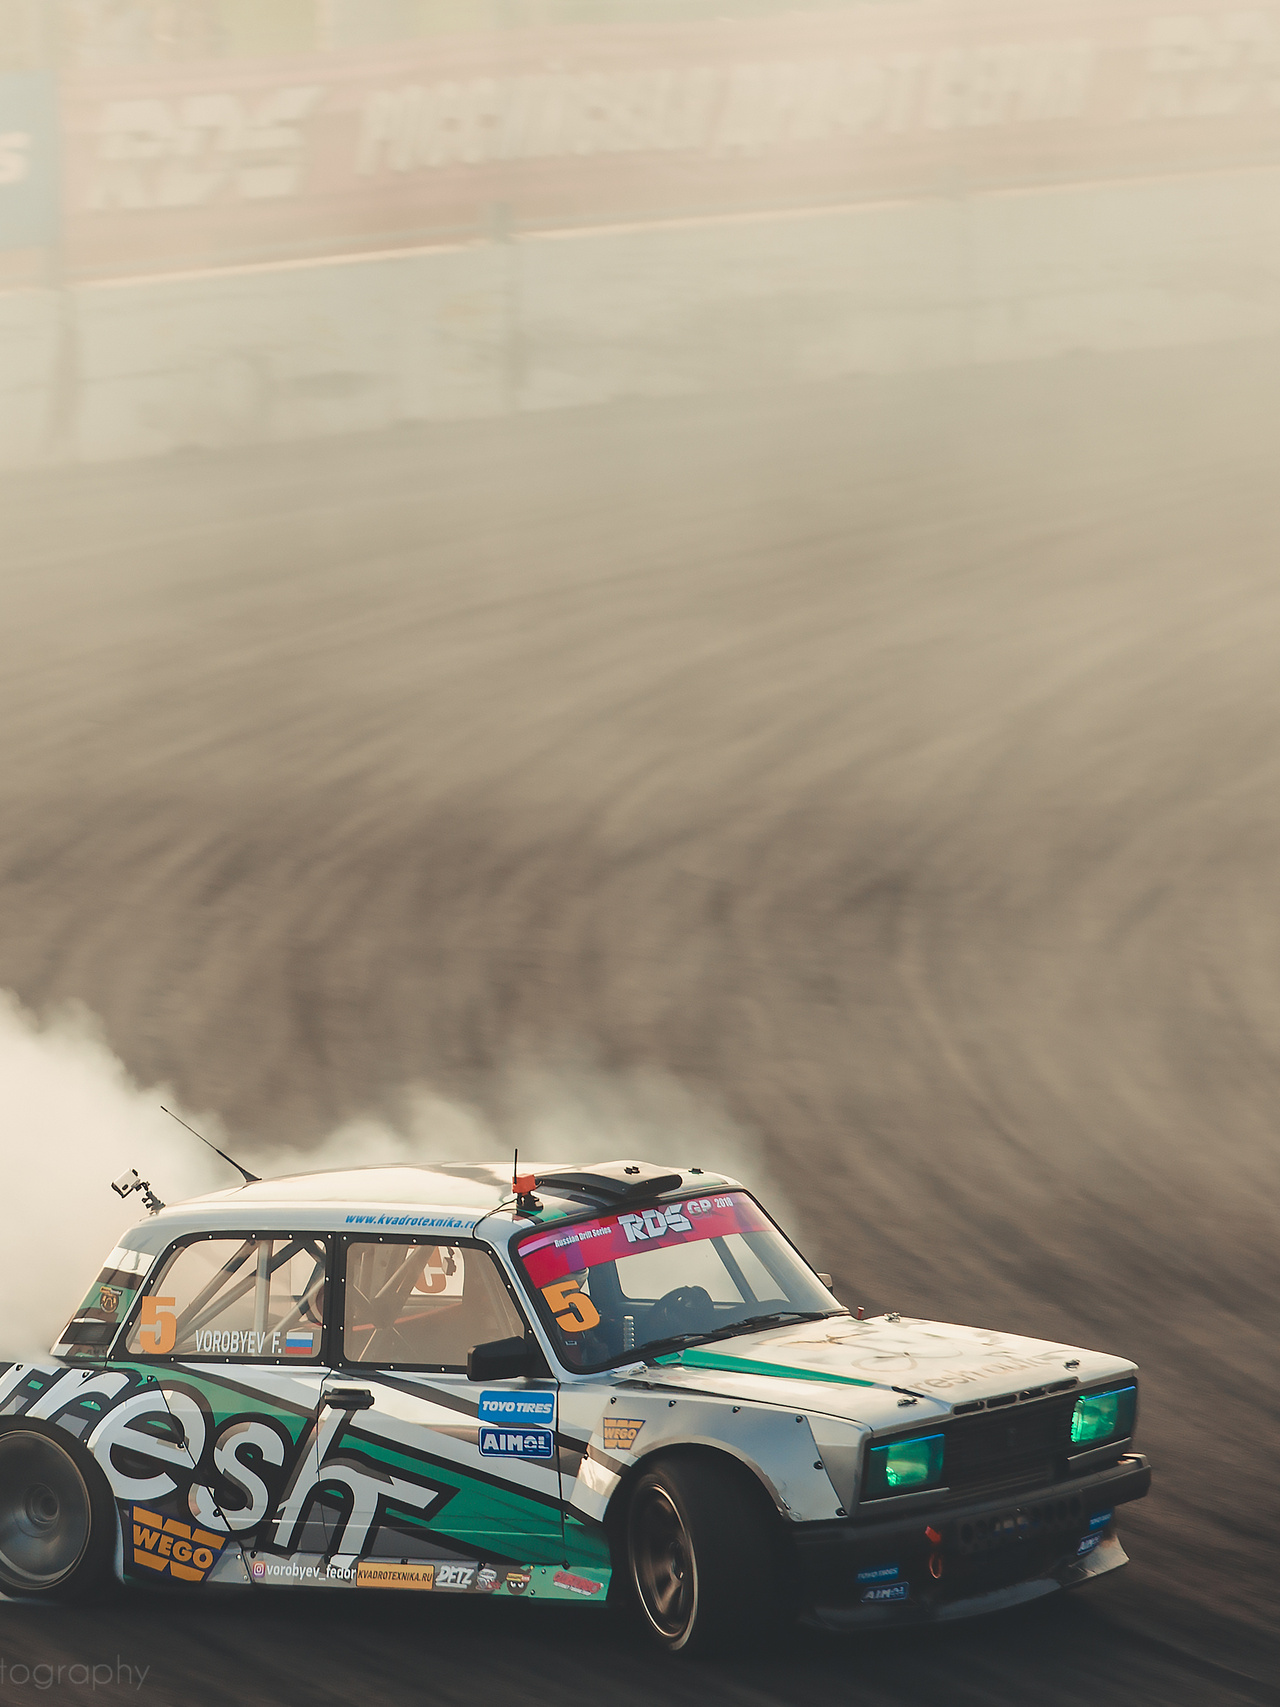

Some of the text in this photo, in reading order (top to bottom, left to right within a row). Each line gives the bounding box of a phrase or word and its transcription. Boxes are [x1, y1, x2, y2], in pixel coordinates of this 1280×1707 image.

[617, 1197, 734, 1243] RDS GP 2018
[554, 1226, 612, 1248] Russian Drift Series
[541, 1280, 600, 1333] 5
[139, 1296, 177, 1354] 5
[195, 1330, 282, 1354] VOROBYEV F.
[482, 1401, 552, 1414] TOYO TIRES
[483, 1433, 550, 1452] AIMOL
[604, 1427, 637, 1440] WEGO
[133, 1524, 213, 1569] WEGO
[266, 1563, 358, 1581] vorobyev_fedor
[358, 1568, 432, 1582] KVADROTEXNIKA.RU
